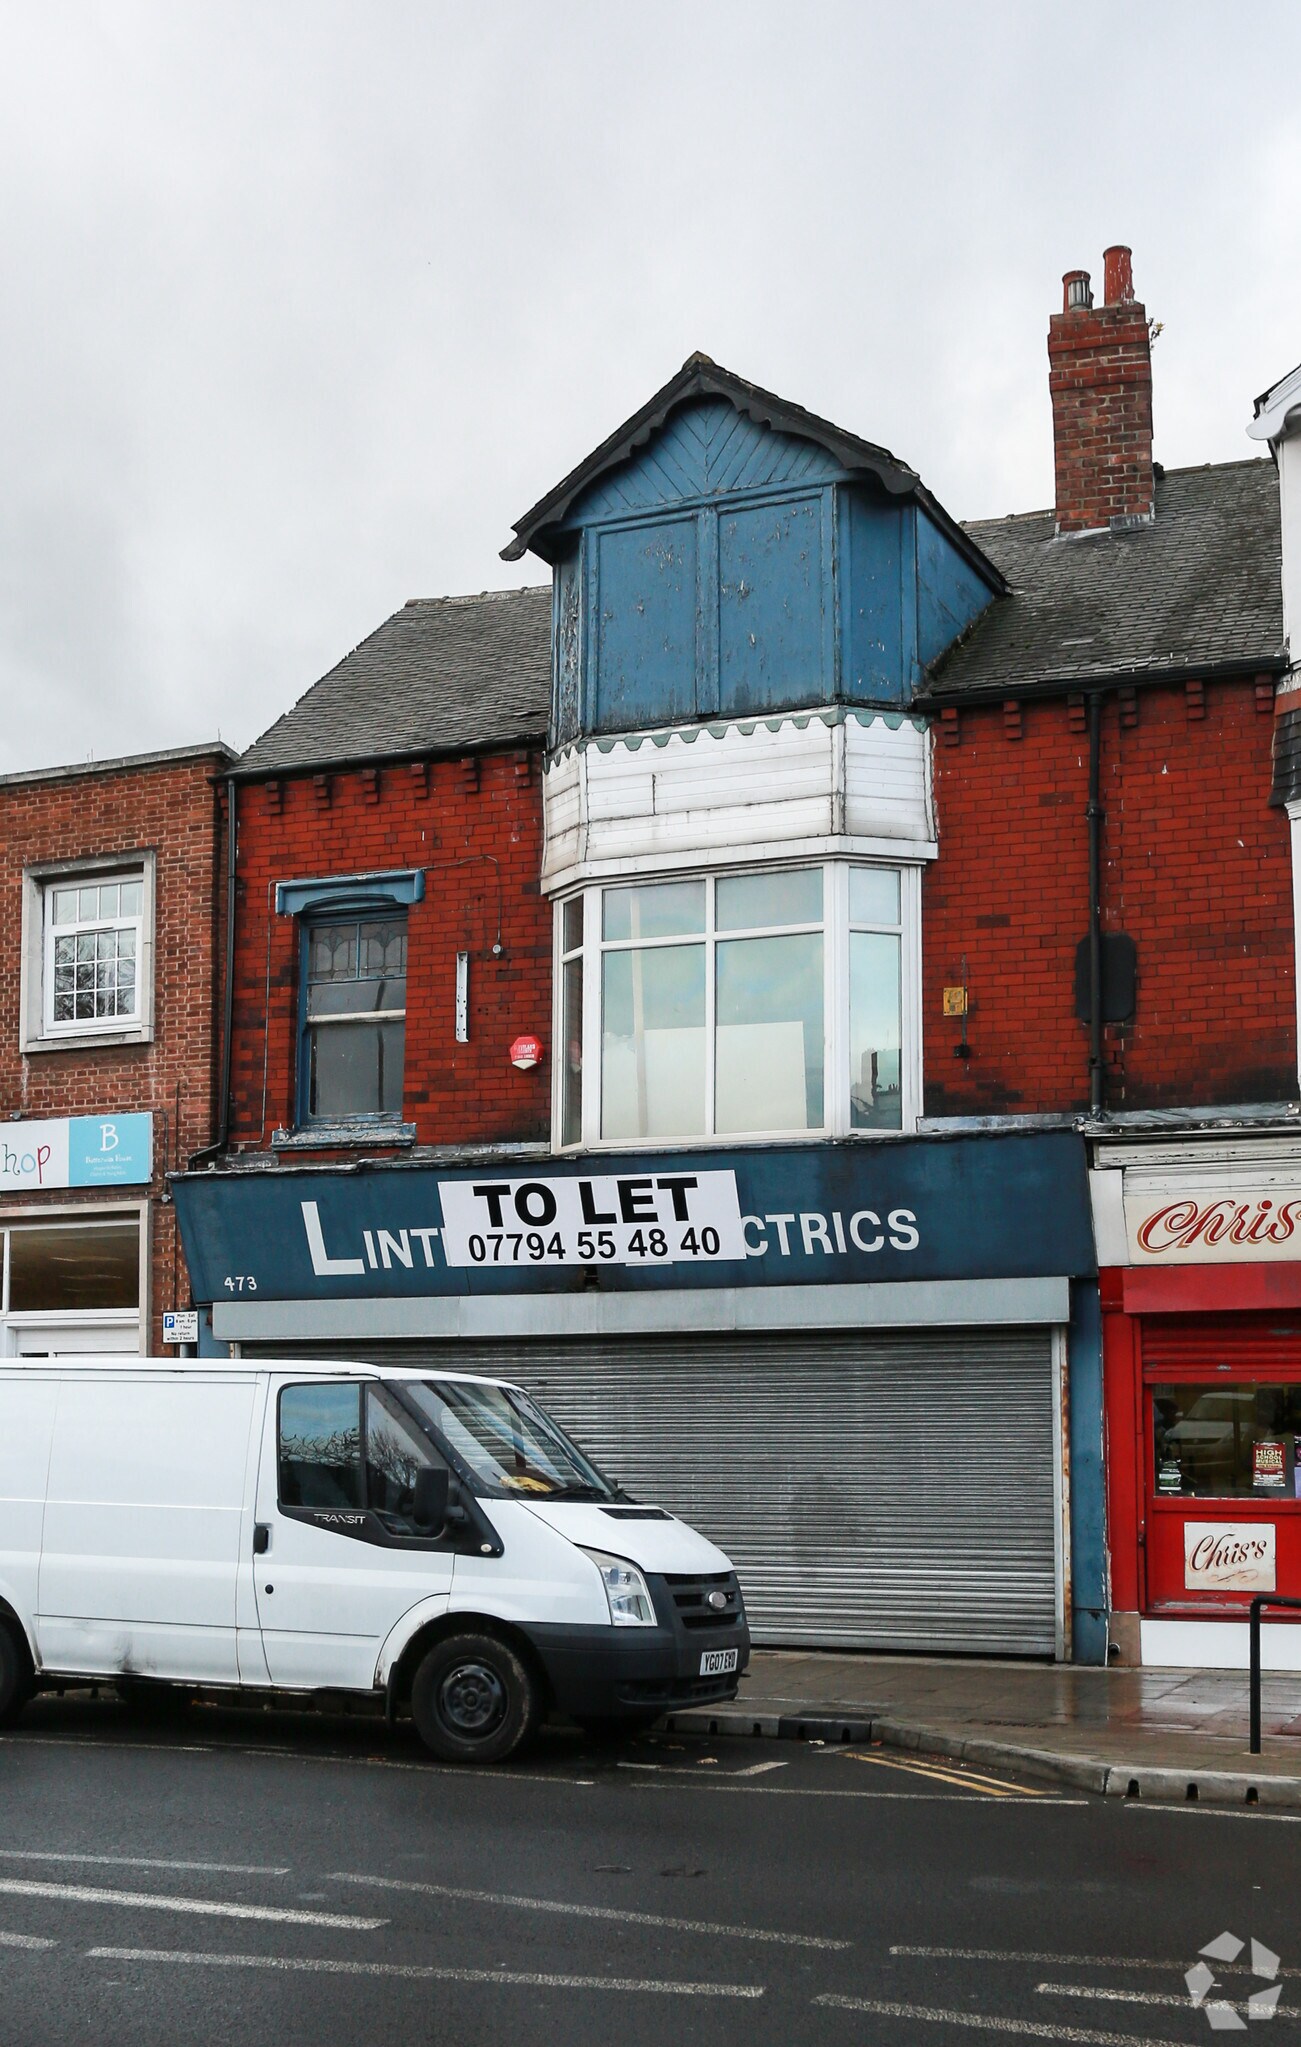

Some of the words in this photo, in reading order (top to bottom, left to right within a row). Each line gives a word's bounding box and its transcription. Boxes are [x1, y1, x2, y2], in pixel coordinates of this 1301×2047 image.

[100, 1123, 119, 1151] B
[472, 1182, 558, 1228] TO
[578, 1176, 699, 1225] LET
[468, 1231, 567, 1262] 07794
[577, 1230, 617, 1260] 55
[627, 1228, 669, 1257] 48
[680, 1226, 721, 1256] 40
[224, 1276, 257, 1292] 473
[314, 1513, 366, 1524] TRANSIT
[1189, 1533, 1267, 1572] Chris's
